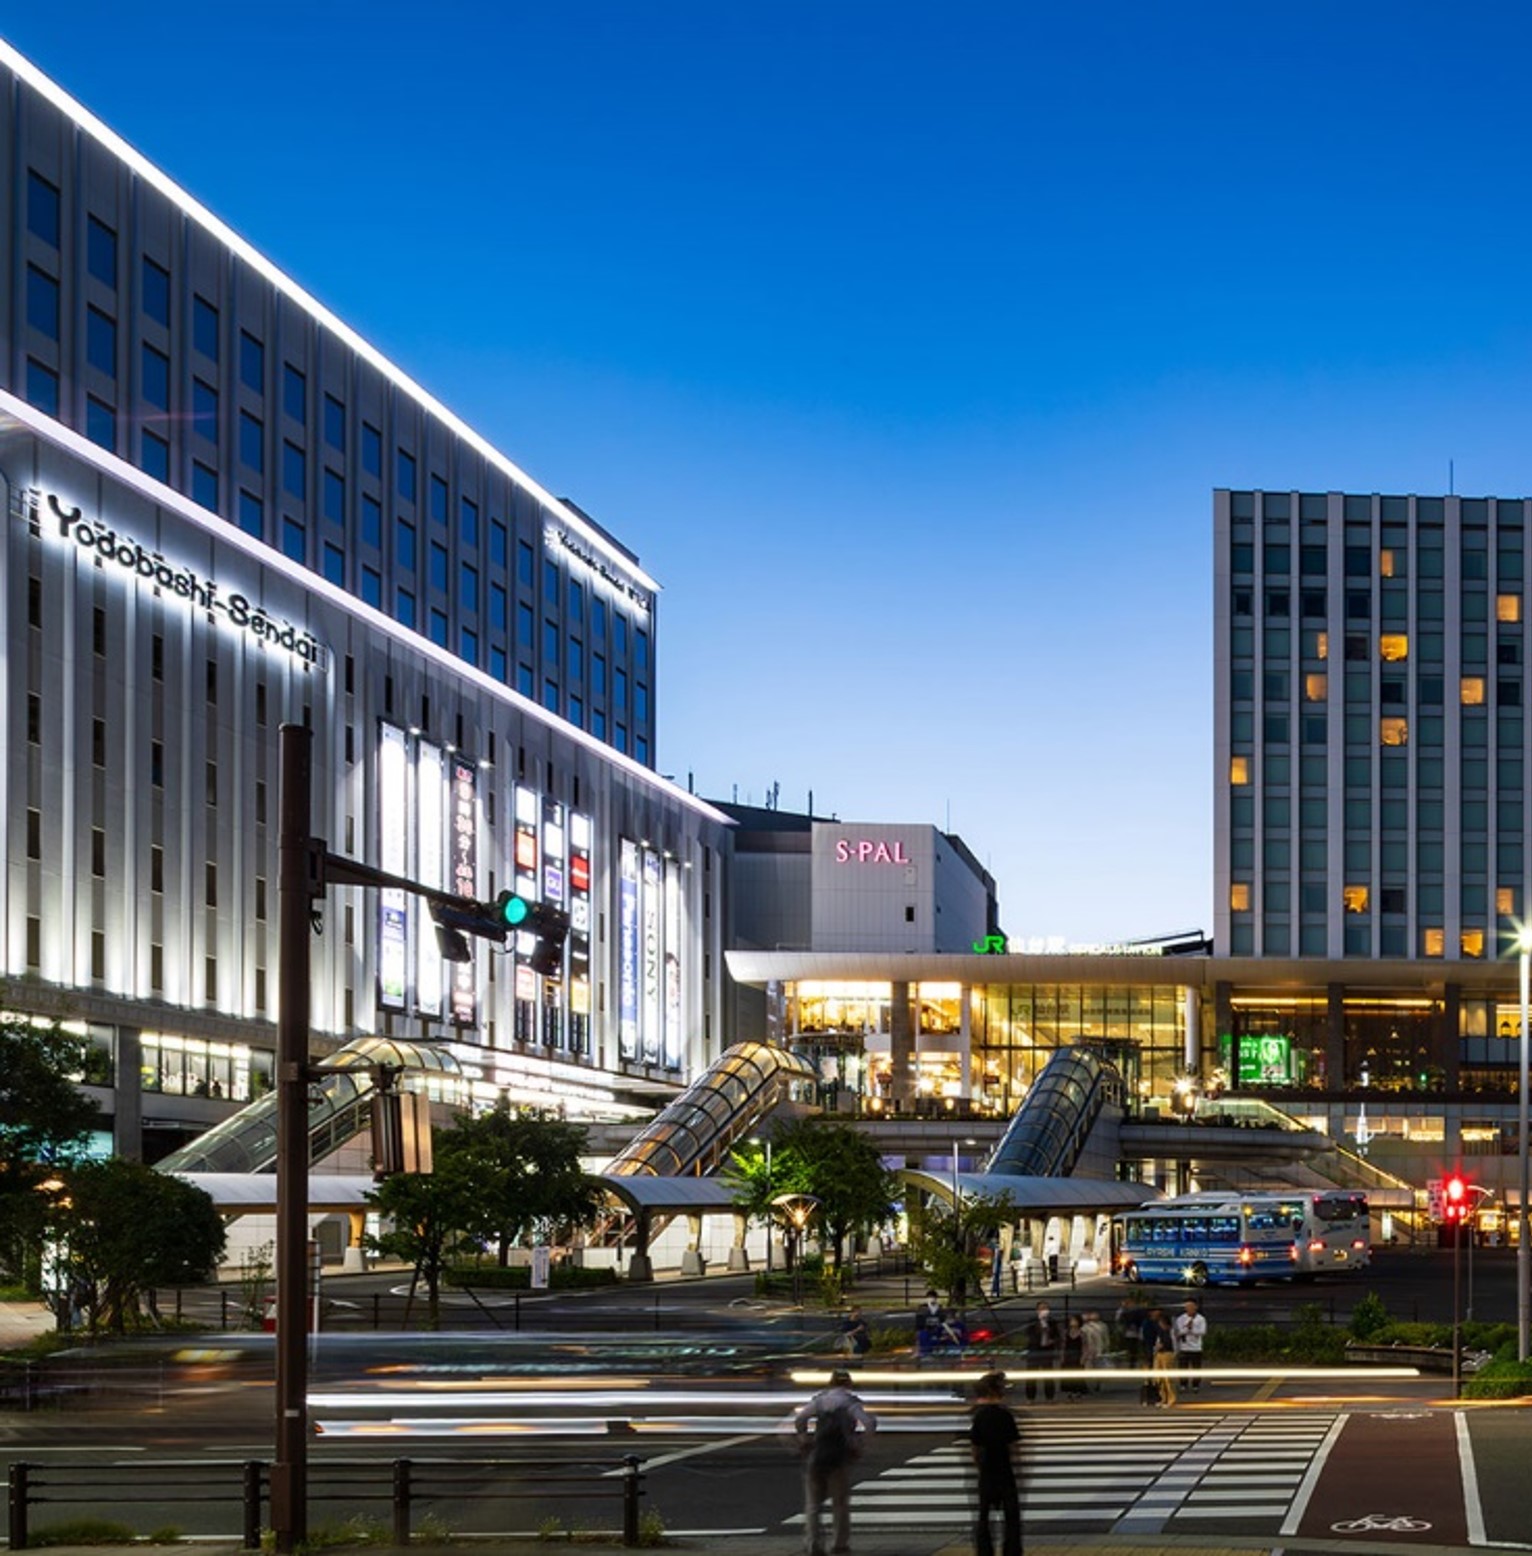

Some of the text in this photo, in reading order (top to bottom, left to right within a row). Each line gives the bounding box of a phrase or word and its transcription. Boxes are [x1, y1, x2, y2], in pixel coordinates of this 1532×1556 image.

[836, 840, 910, 863] S-PAL
[646, 910, 657, 1002] SONY
[973, 936, 1005, 954] JR
